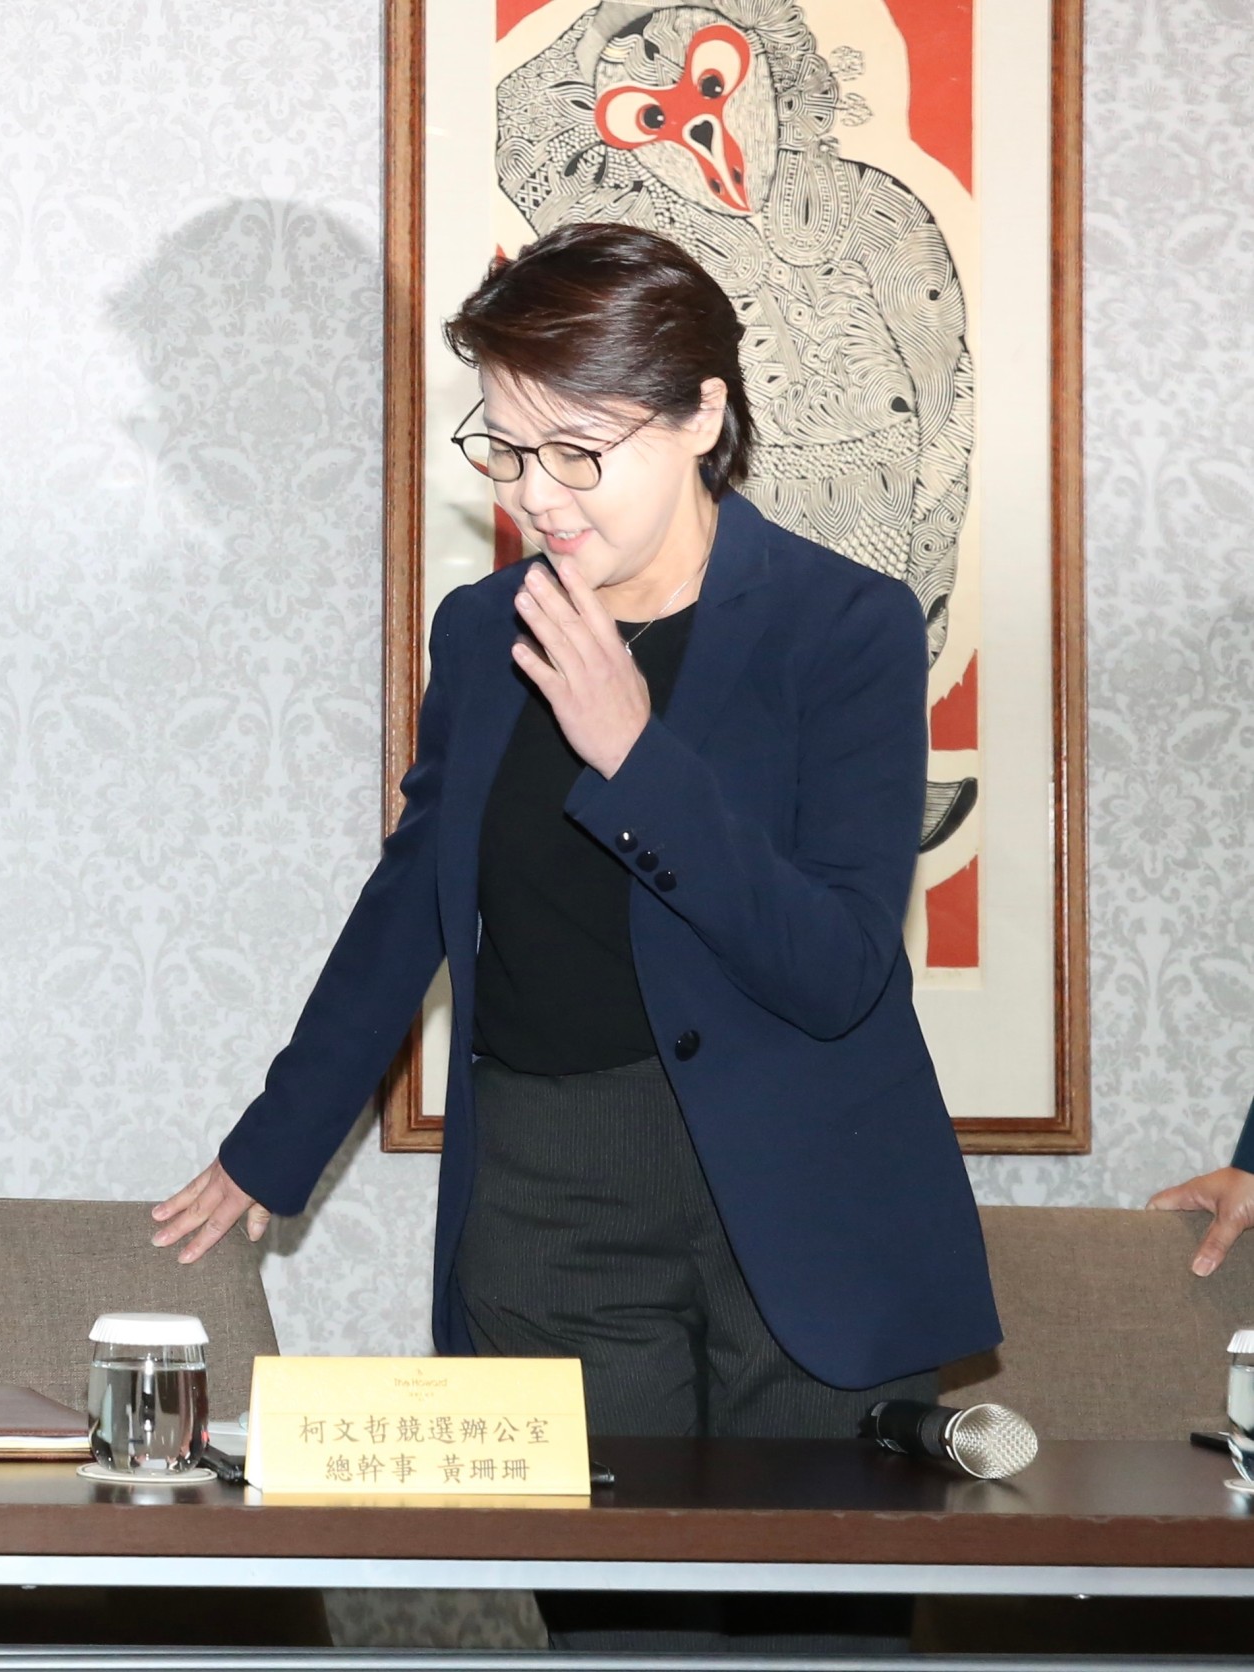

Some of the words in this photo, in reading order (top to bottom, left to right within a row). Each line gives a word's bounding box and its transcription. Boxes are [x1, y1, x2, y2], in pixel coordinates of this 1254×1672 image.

[299, 1415, 550, 1445] 柯文哲競選辦公室
[325, 1453, 417, 1483] 總幹事
[437, 1454, 530, 1484] 黃珊珊
